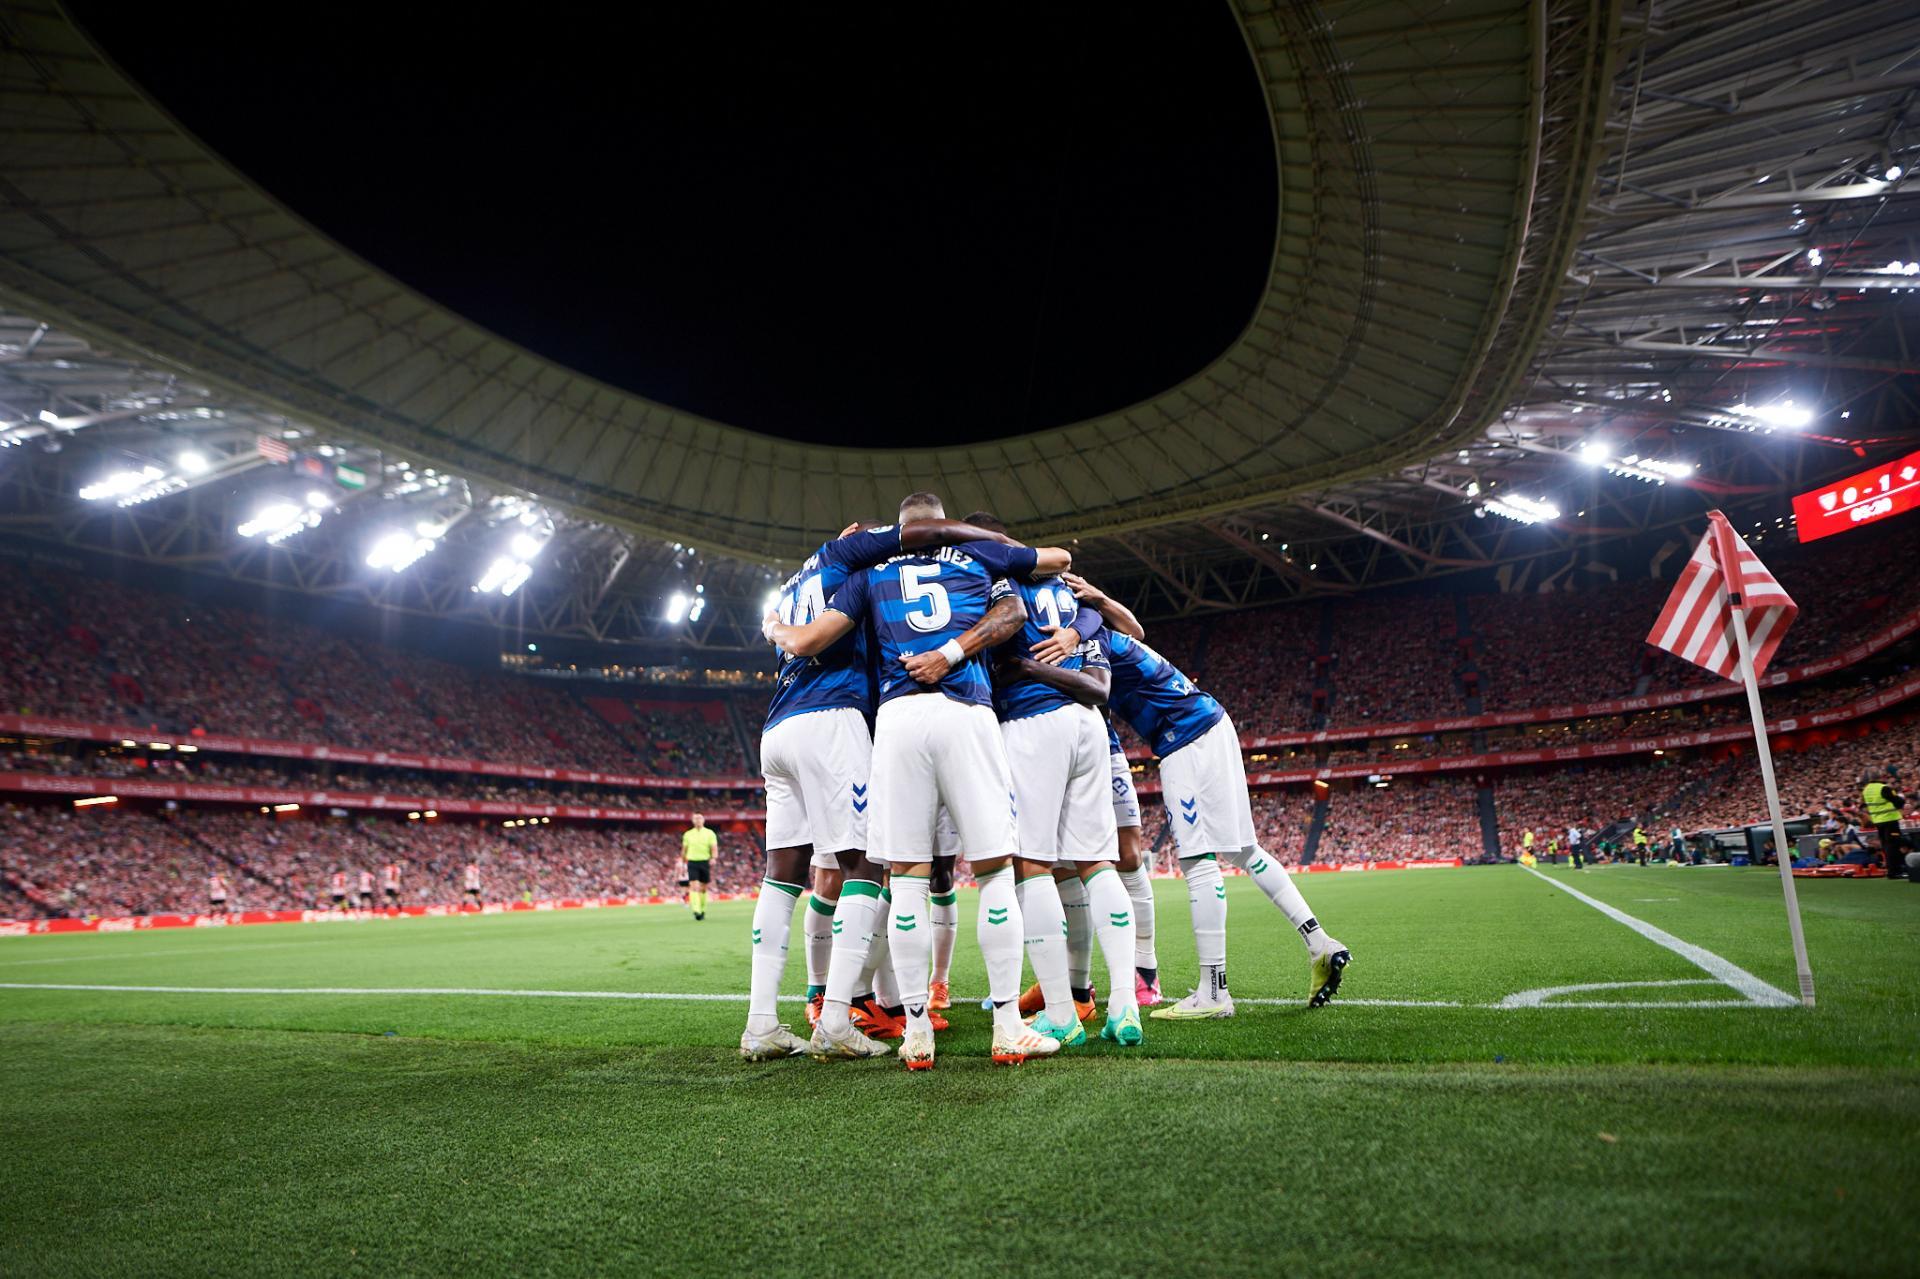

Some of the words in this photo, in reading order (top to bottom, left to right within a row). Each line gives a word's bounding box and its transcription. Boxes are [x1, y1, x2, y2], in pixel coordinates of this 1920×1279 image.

[899, 564, 951, 633] 5
[1622, 698, 1648, 710] IMQ
[1658, 693, 1682, 705] IMQ
[1631, 741, 1657, 752] IMQ
[1665, 736, 1691, 748] IMQ
